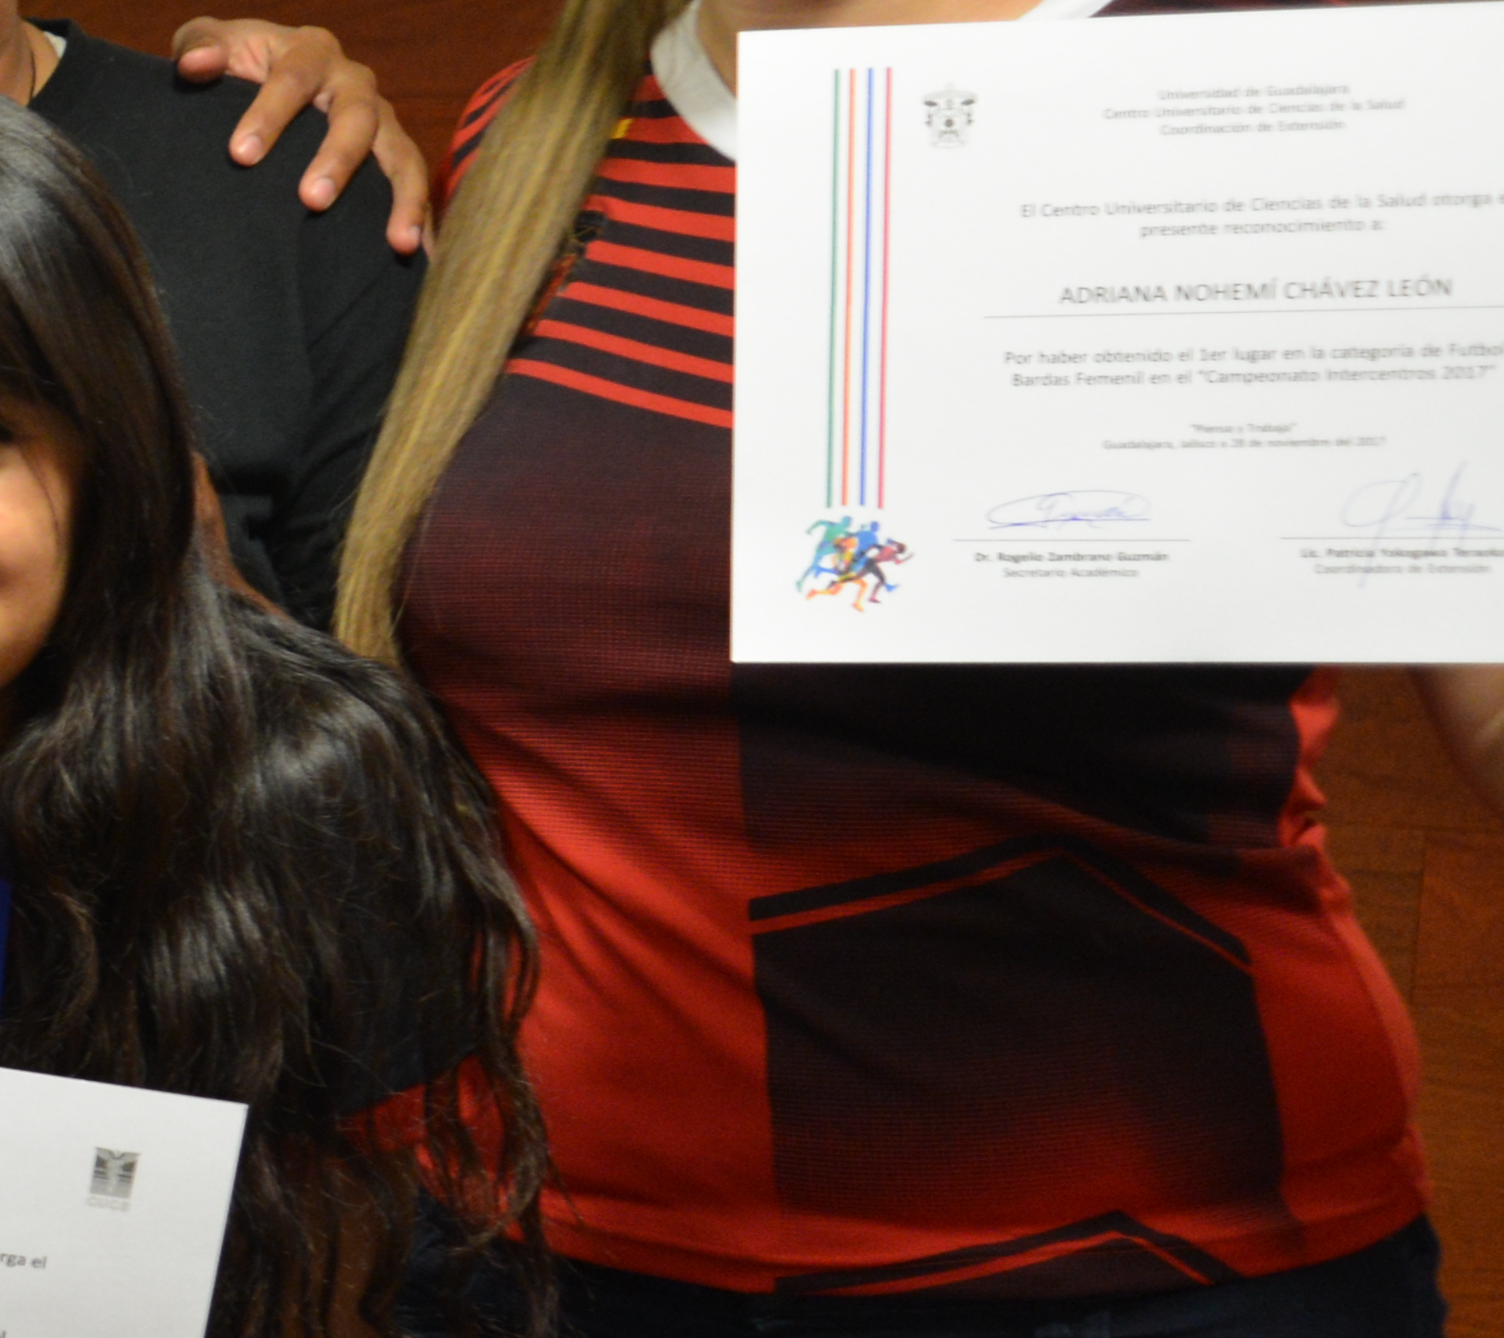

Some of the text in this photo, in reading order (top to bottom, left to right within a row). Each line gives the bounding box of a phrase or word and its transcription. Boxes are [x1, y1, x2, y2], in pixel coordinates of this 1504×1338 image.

[1059, 274, 1453, 304] ADRIANA NOHEMÍ CHÁVEZ LEÓN
[29, 1255, 47, 1269] el
